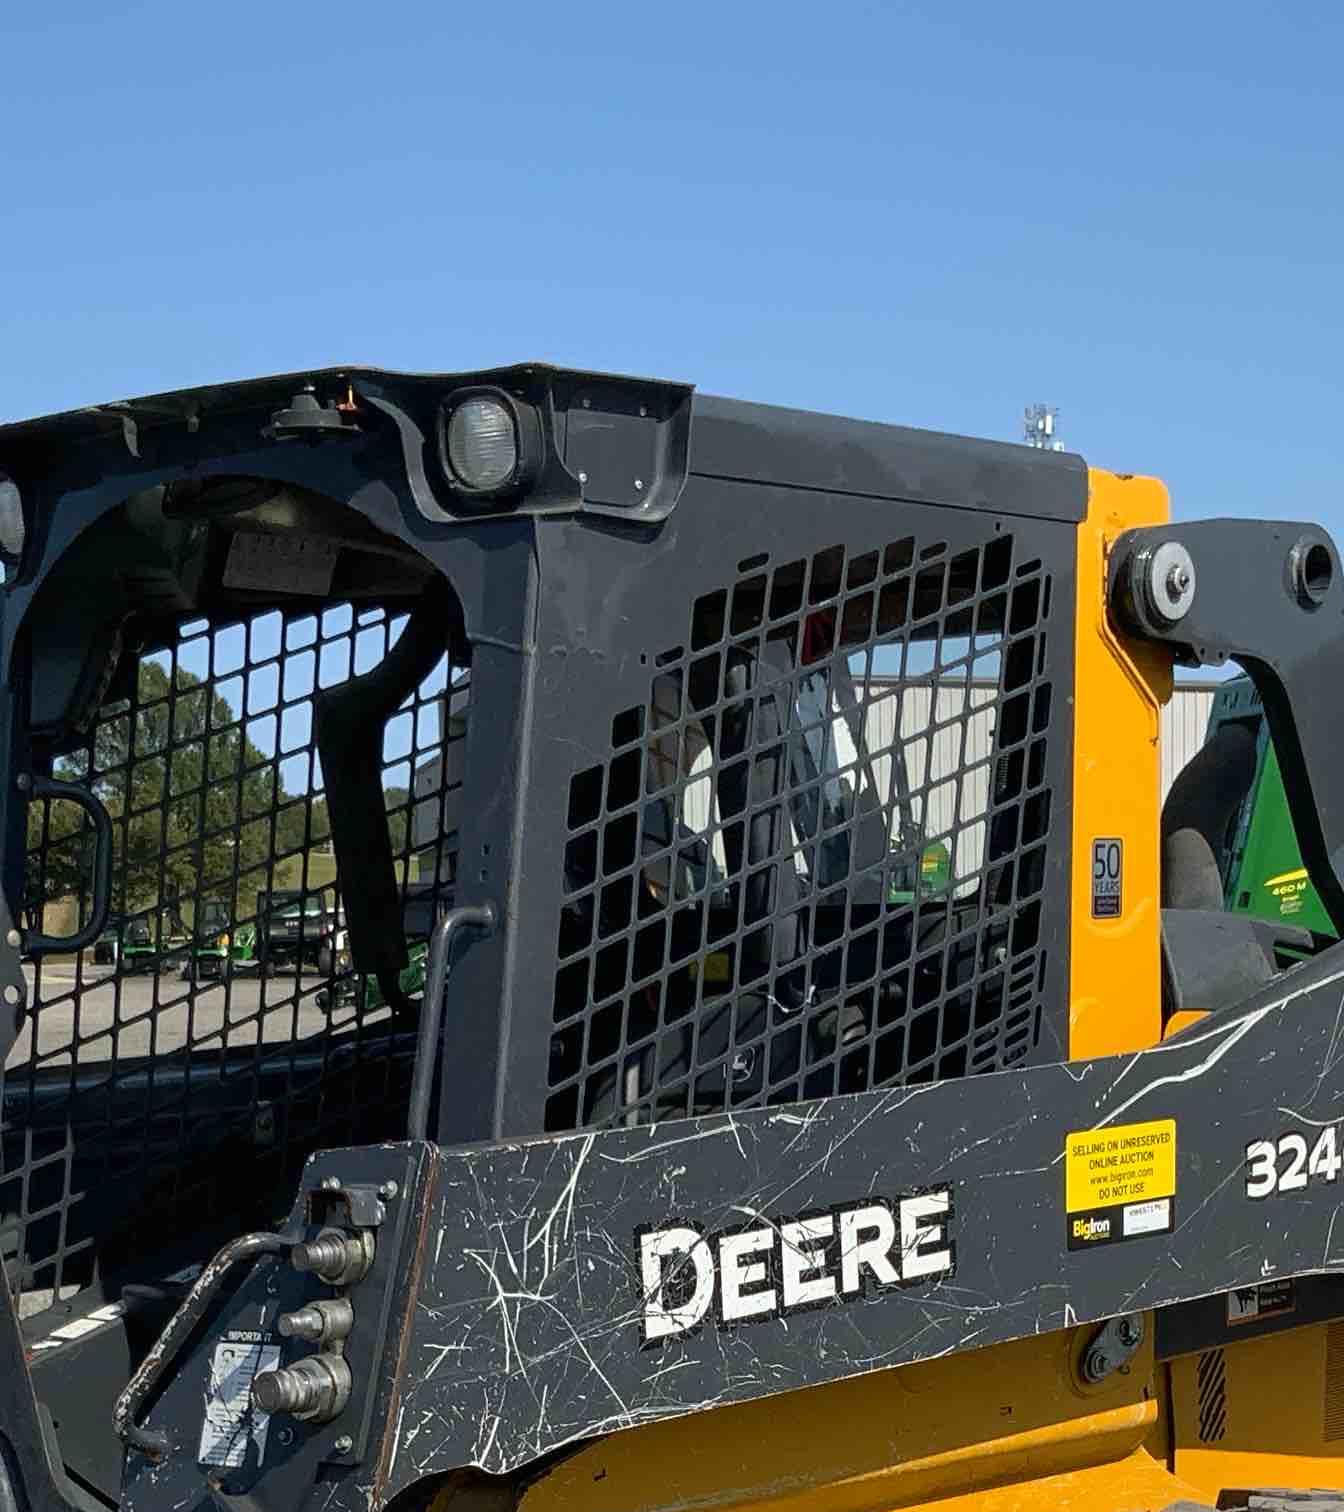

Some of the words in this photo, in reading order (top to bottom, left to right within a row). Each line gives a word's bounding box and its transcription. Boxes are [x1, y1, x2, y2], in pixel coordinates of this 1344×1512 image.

[1095, 843, 1120, 879] 50
[1072, 1143, 1106, 1158] SELLING
[1107, 1141, 1119, 1152] ON
[1120, 1132, 1171, 1150] UNRESERVED
[1089, 1156, 1118, 1170] ONLINE
[1120, 1151, 1154, 1165] AUCTION
[1090, 1167, 1154, 1185] www.bigiron.com
[1099, 1188, 1111, 1200] DO
[1112, 1184, 1128, 1198] NOT
[1130, 1182, 1145, 1194] USE
[1073, 1217, 1111, 1240] BigIron
[640, 1191, 952, 1339] DEERE
